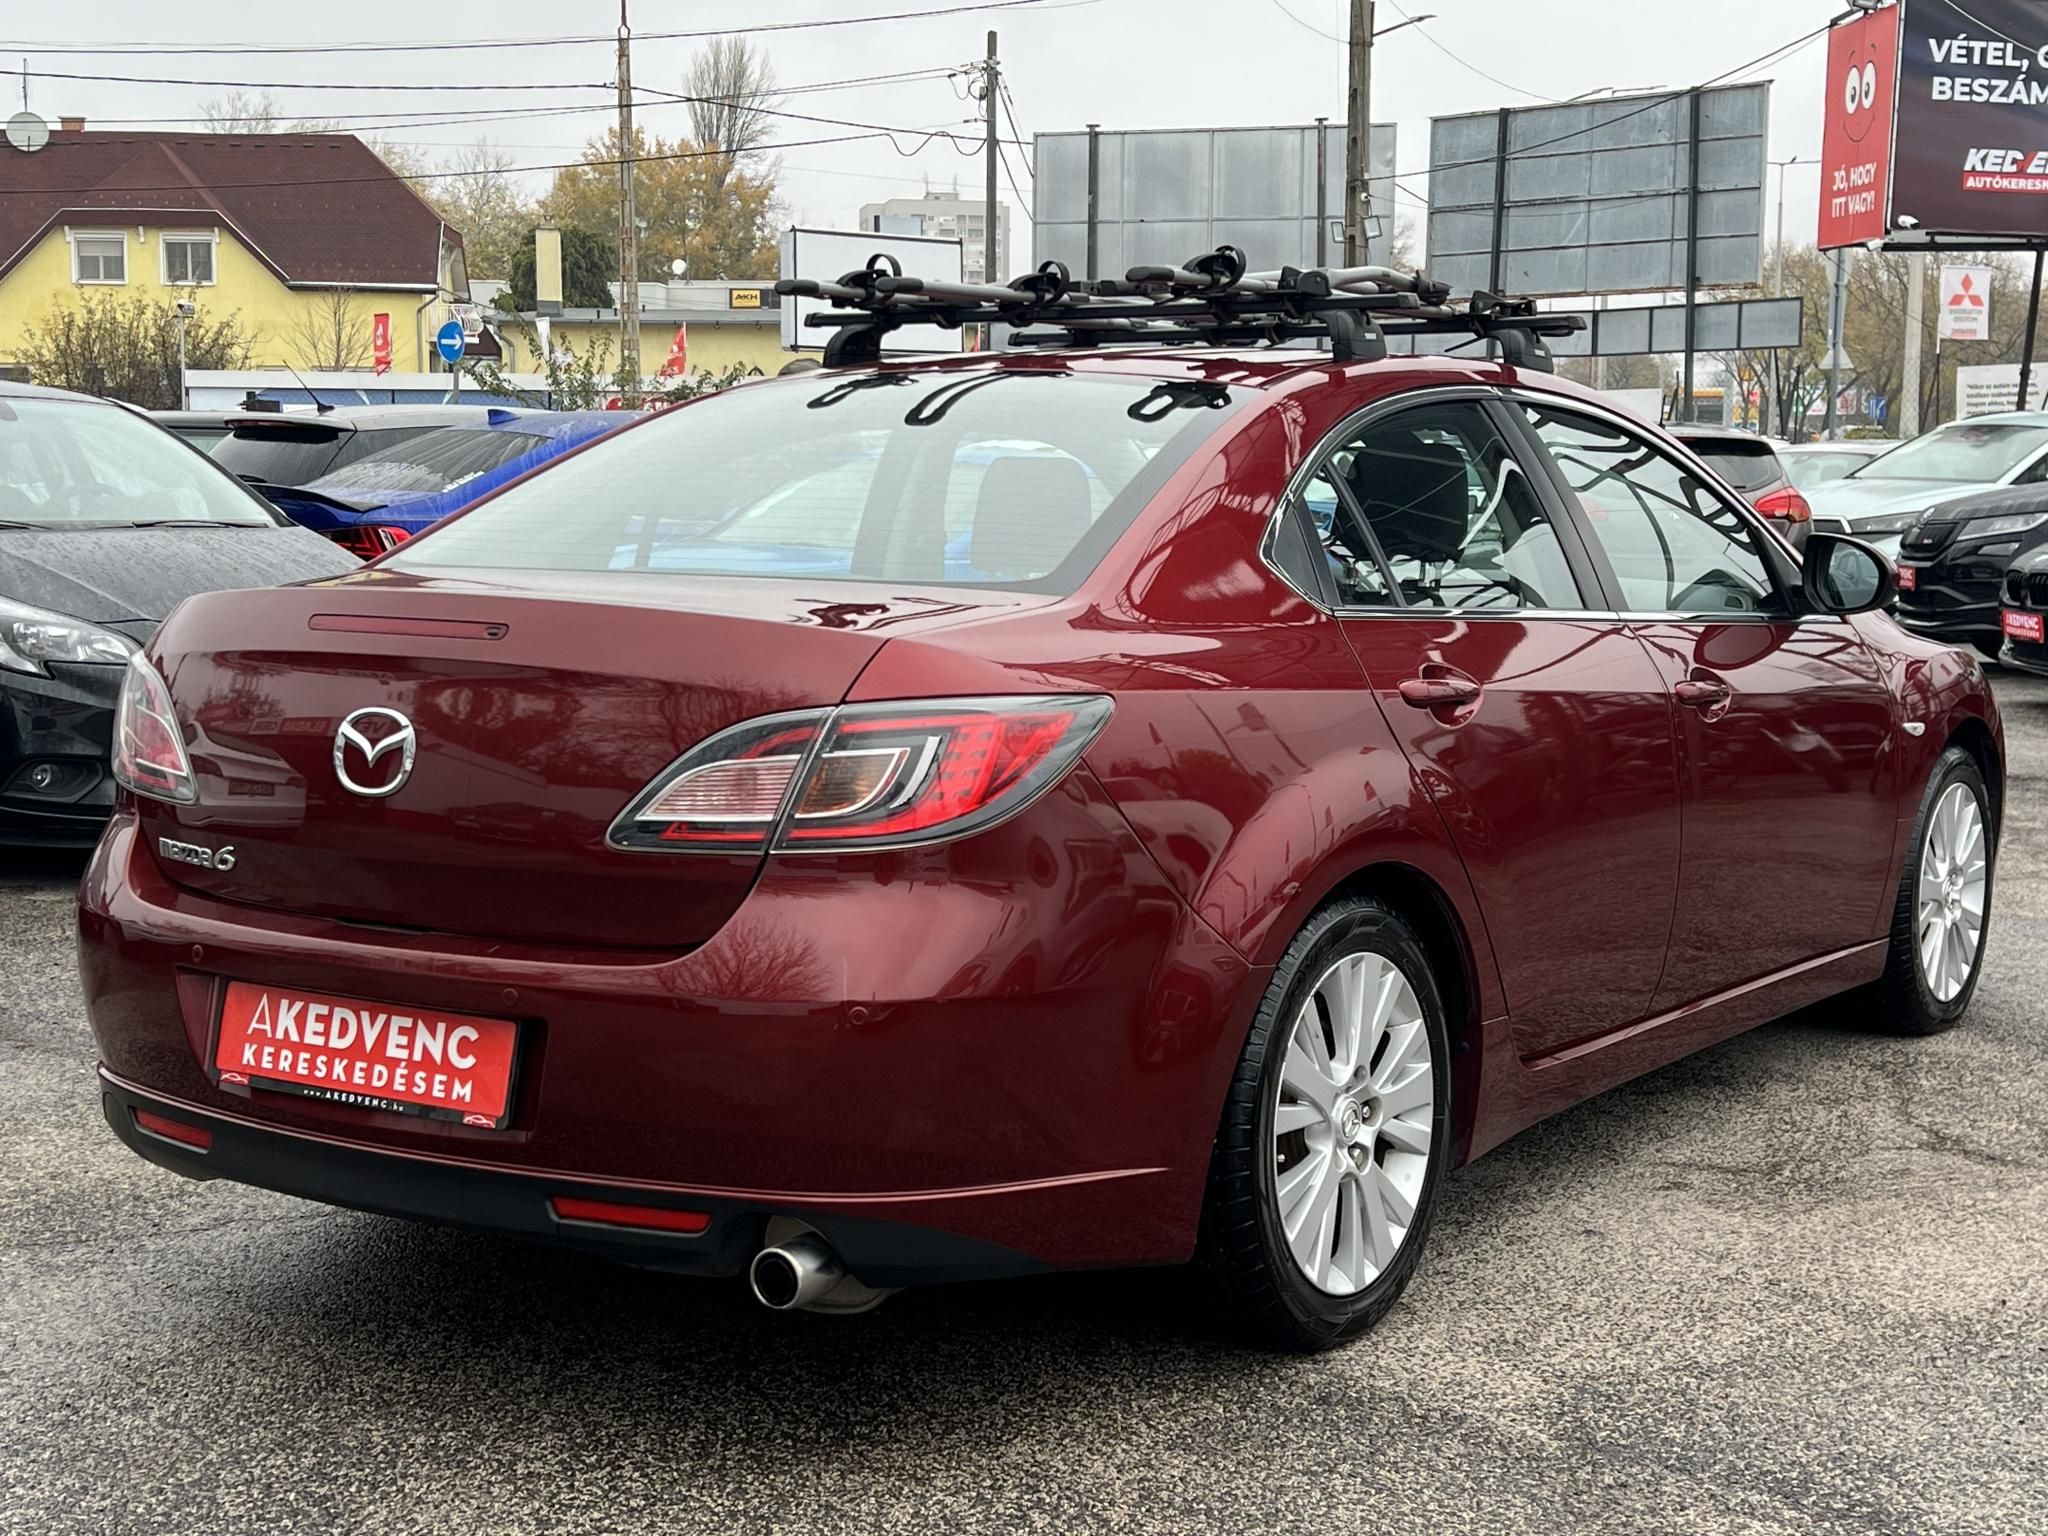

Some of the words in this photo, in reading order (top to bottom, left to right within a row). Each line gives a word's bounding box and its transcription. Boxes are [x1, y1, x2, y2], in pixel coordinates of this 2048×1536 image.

[1928, 33, 2030, 72] VÉTEL,
[1832, 163, 1848, 192] JÓ,
[1850, 161, 1877, 188] HOGY
[1831, 196, 1847, 218] ITT
[1848, 190, 1876, 215] VAGY!
[246, 991, 480, 1070] AKEDVENC
[241, 1042, 473, 1103] KERESKEDÉSEM
